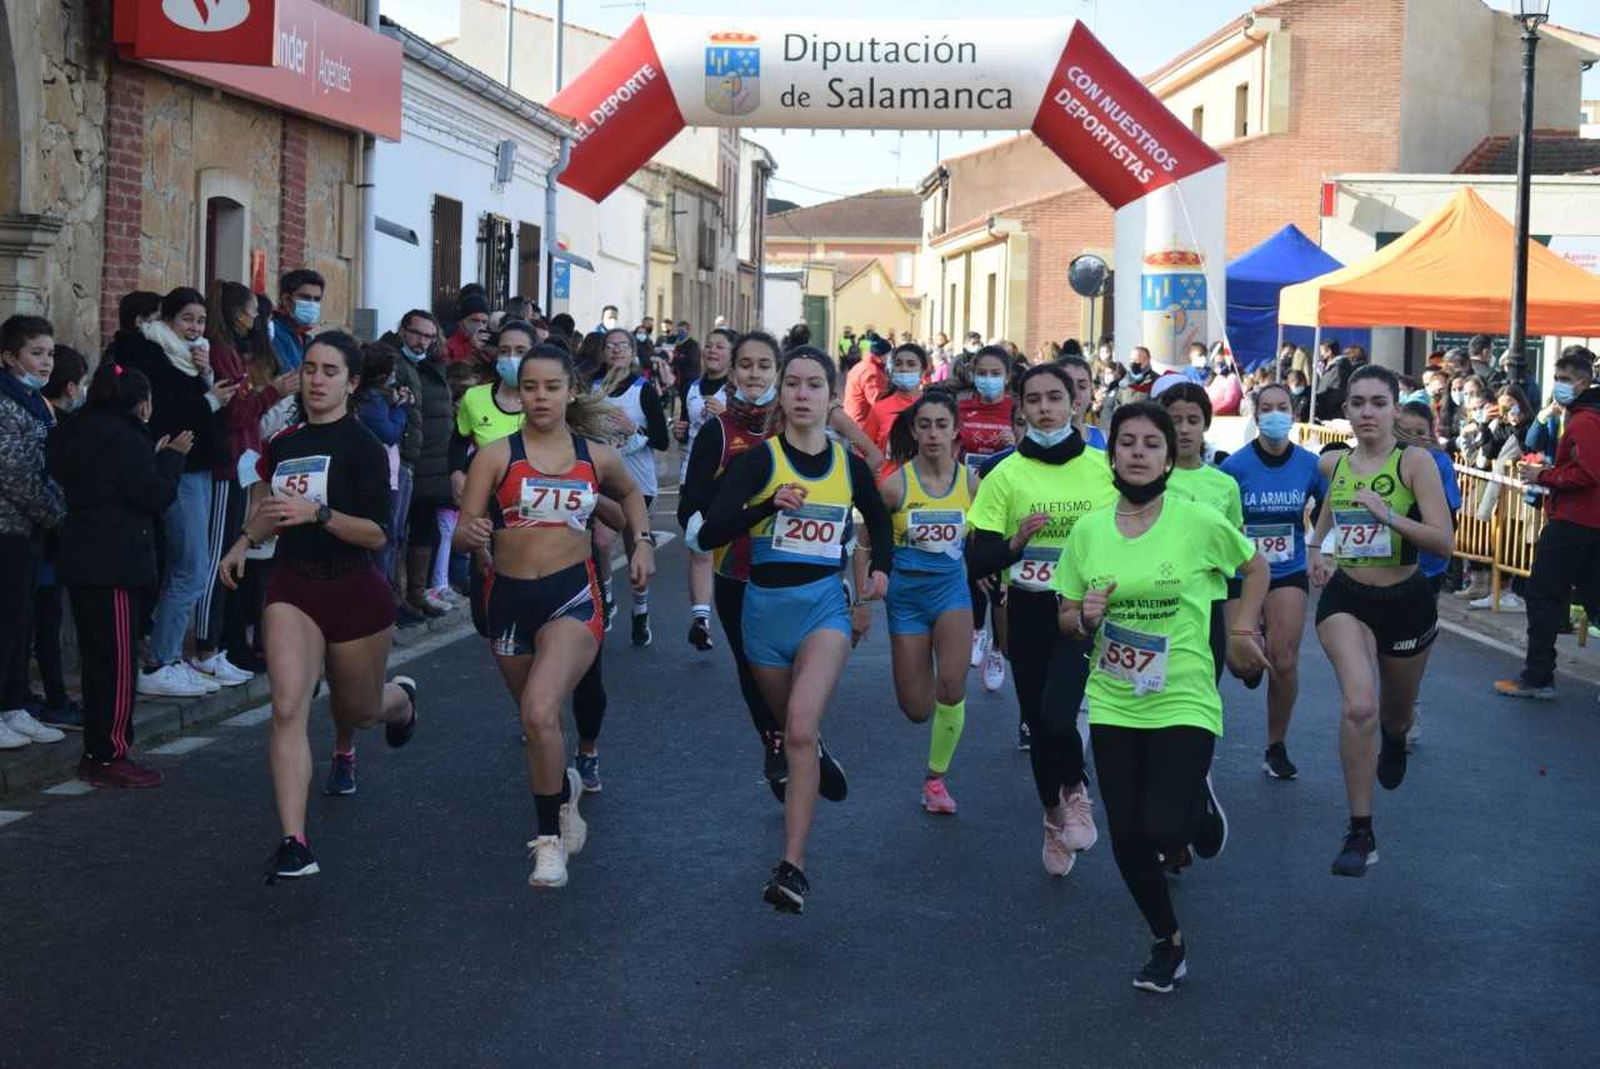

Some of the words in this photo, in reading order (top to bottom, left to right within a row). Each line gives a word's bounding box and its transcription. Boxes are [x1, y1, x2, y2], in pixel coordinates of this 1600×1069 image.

[278, 24, 309, 76] nder
[783, 33, 978, 72] Diputación
[319, 49, 352, 95] Agentes
[589, 63, 658, 127] DEPORTE
[780, 84, 811, 108] de
[826, 77, 1013, 110] Salamanca
[1067, 66, 1104, 101] CON
[1098, 95, 1178, 172] NUESTROS
[1054, 88, 1154, 184] DEPORTISTAS
[286, 473, 310, 495] 55
[531, 488, 583, 511] 715
[1029, 500, 1093, 514] ATLETISMO
[1244, 491, 1257, 506] LA
[784, 518, 836, 543] 200
[916, 524, 957, 541] 230
[1341, 525, 1379, 546] 737
[1253, 536, 1288, 553] 198
[1020, 560, 1058, 582] 56
[1107, 641, 1157, 673] 537
